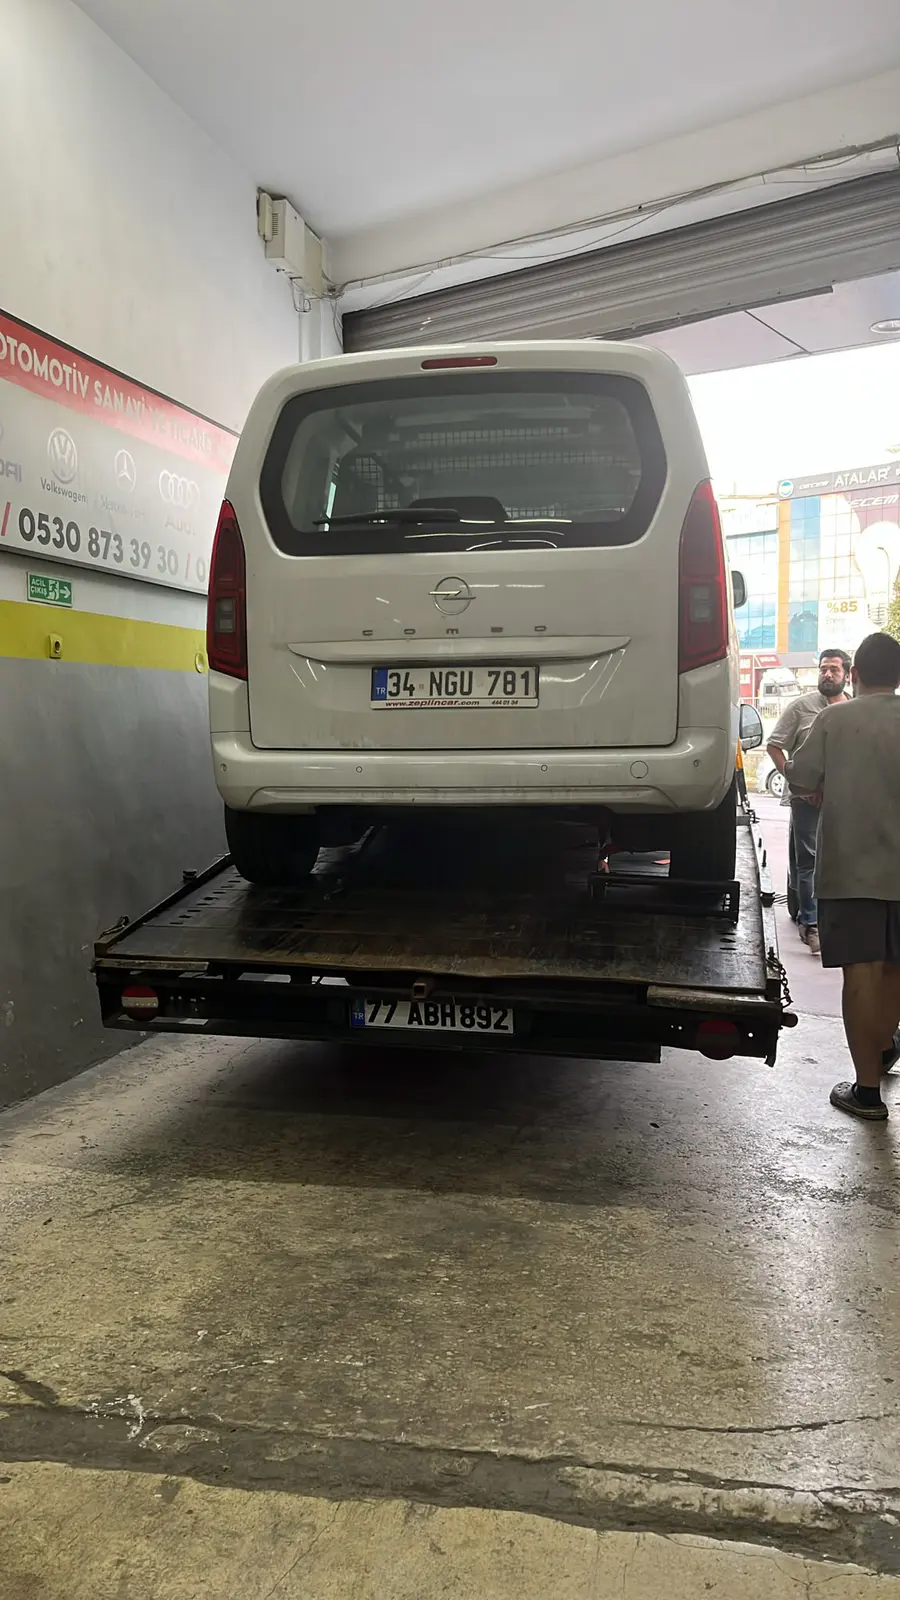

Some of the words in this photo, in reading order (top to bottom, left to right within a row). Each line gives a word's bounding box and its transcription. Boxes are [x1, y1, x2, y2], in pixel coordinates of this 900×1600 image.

[40, 477, 87, 503] Volkswagen
[834, 467, 889, 488] ATALAR
[19, 508, 80, 552] 0530
[88, 527, 124, 563] 873
[130, 539, 151, 569] 39
[157, 546, 178, 576] 30
[826, 600, 858, 614] %85
[388, 671, 415, 697] 34
[429, 671, 473, 696] NGU
[487, 670, 530, 696] 781
[385, 699, 480, 708] www.zeplincar.com
[353, 1012, 364, 1020] TR
[366, 1000, 397, 1024] 77
[407, 1001, 457, 1028] ABH
[460, 1004, 509, 1031] 892
